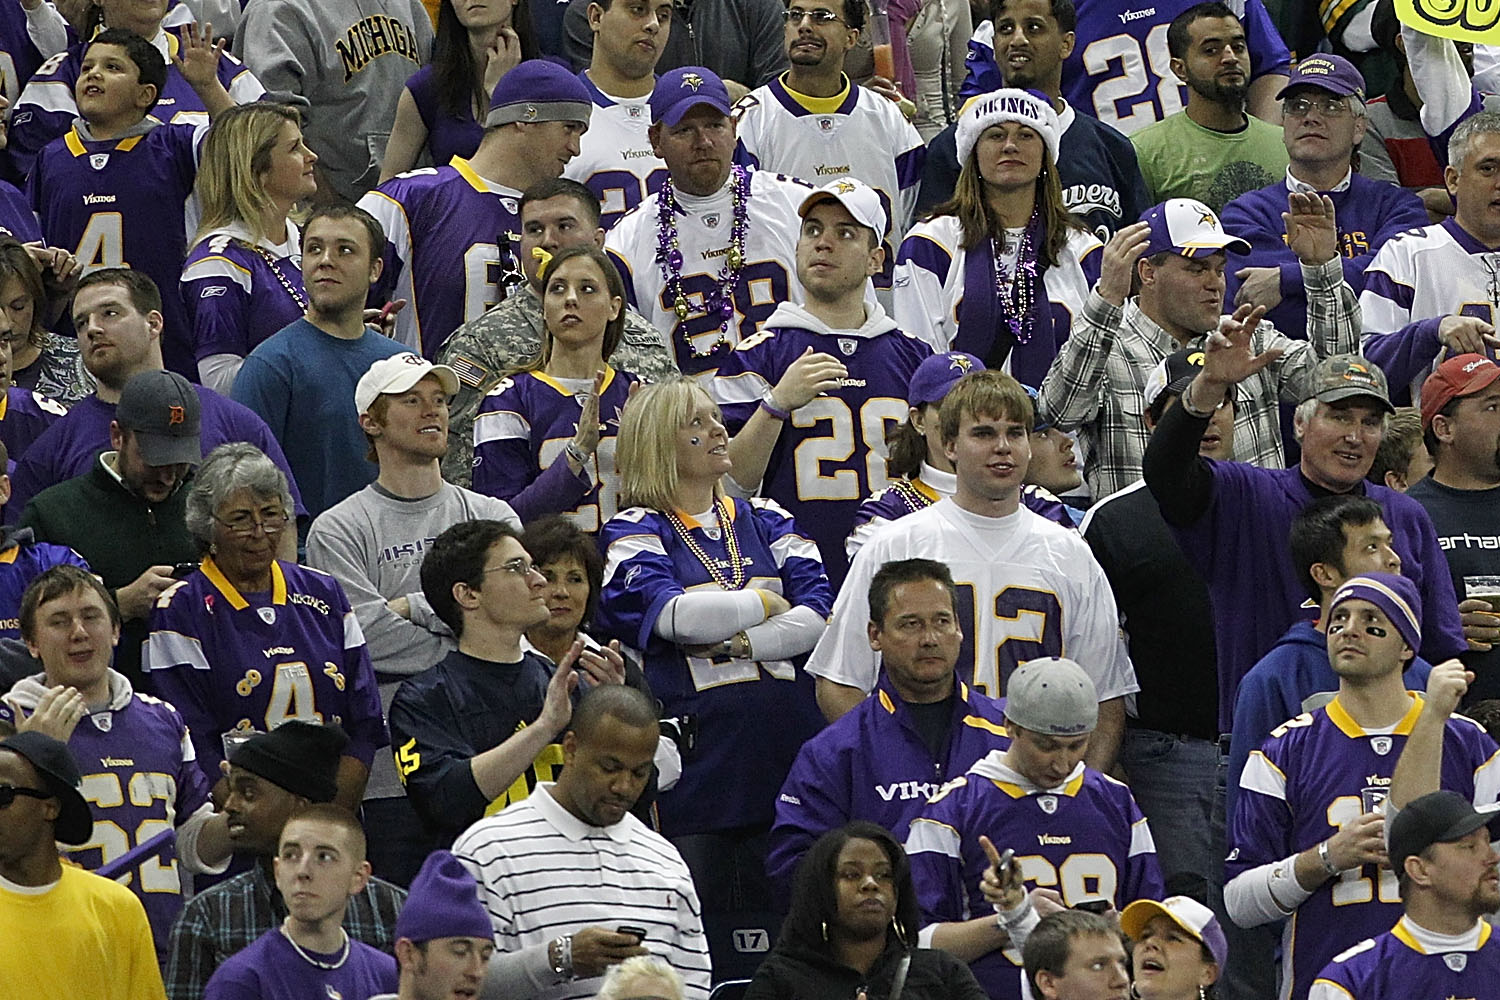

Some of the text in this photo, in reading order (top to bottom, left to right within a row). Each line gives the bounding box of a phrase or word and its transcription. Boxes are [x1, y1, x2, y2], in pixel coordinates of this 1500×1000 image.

[975, 98, 1041, 123] VIKINGS
[74, 213, 130, 272] 4
[265, 661, 324, 730] 4
[736, 932, 763, 950] 17
